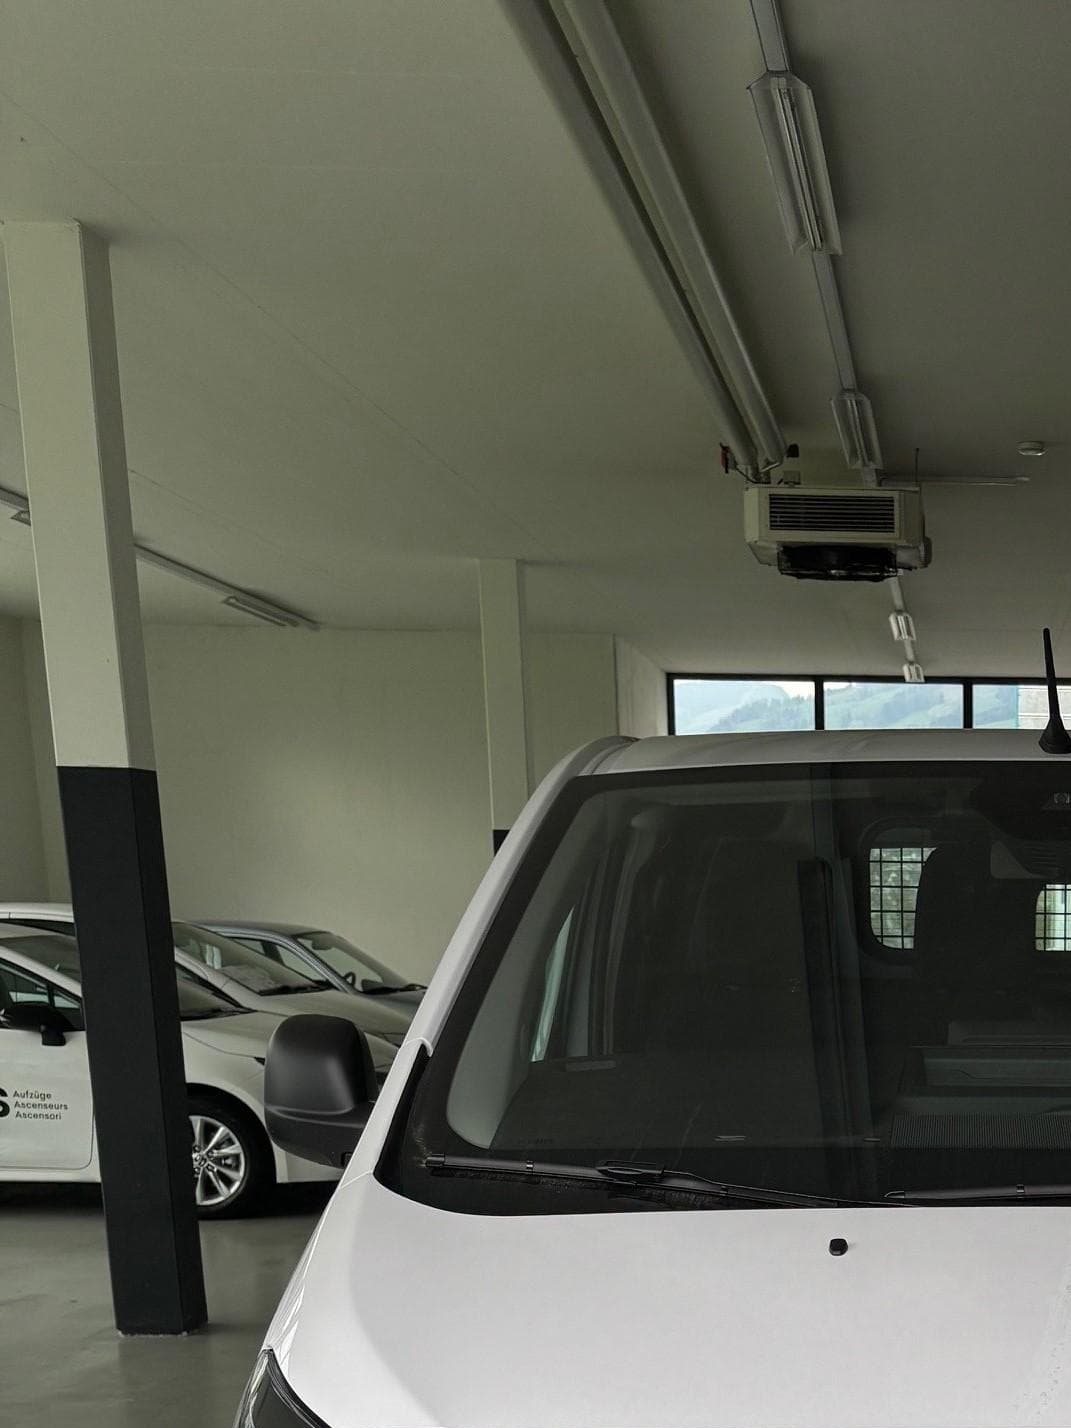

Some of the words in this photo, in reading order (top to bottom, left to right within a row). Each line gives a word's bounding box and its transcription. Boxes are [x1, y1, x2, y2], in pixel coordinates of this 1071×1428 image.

[12, 1090, 52, 1102] Aufzüge
[14, 1101, 69, 1111] Ascenseurs
[15, 1111, 62, 1121] Ascensori
